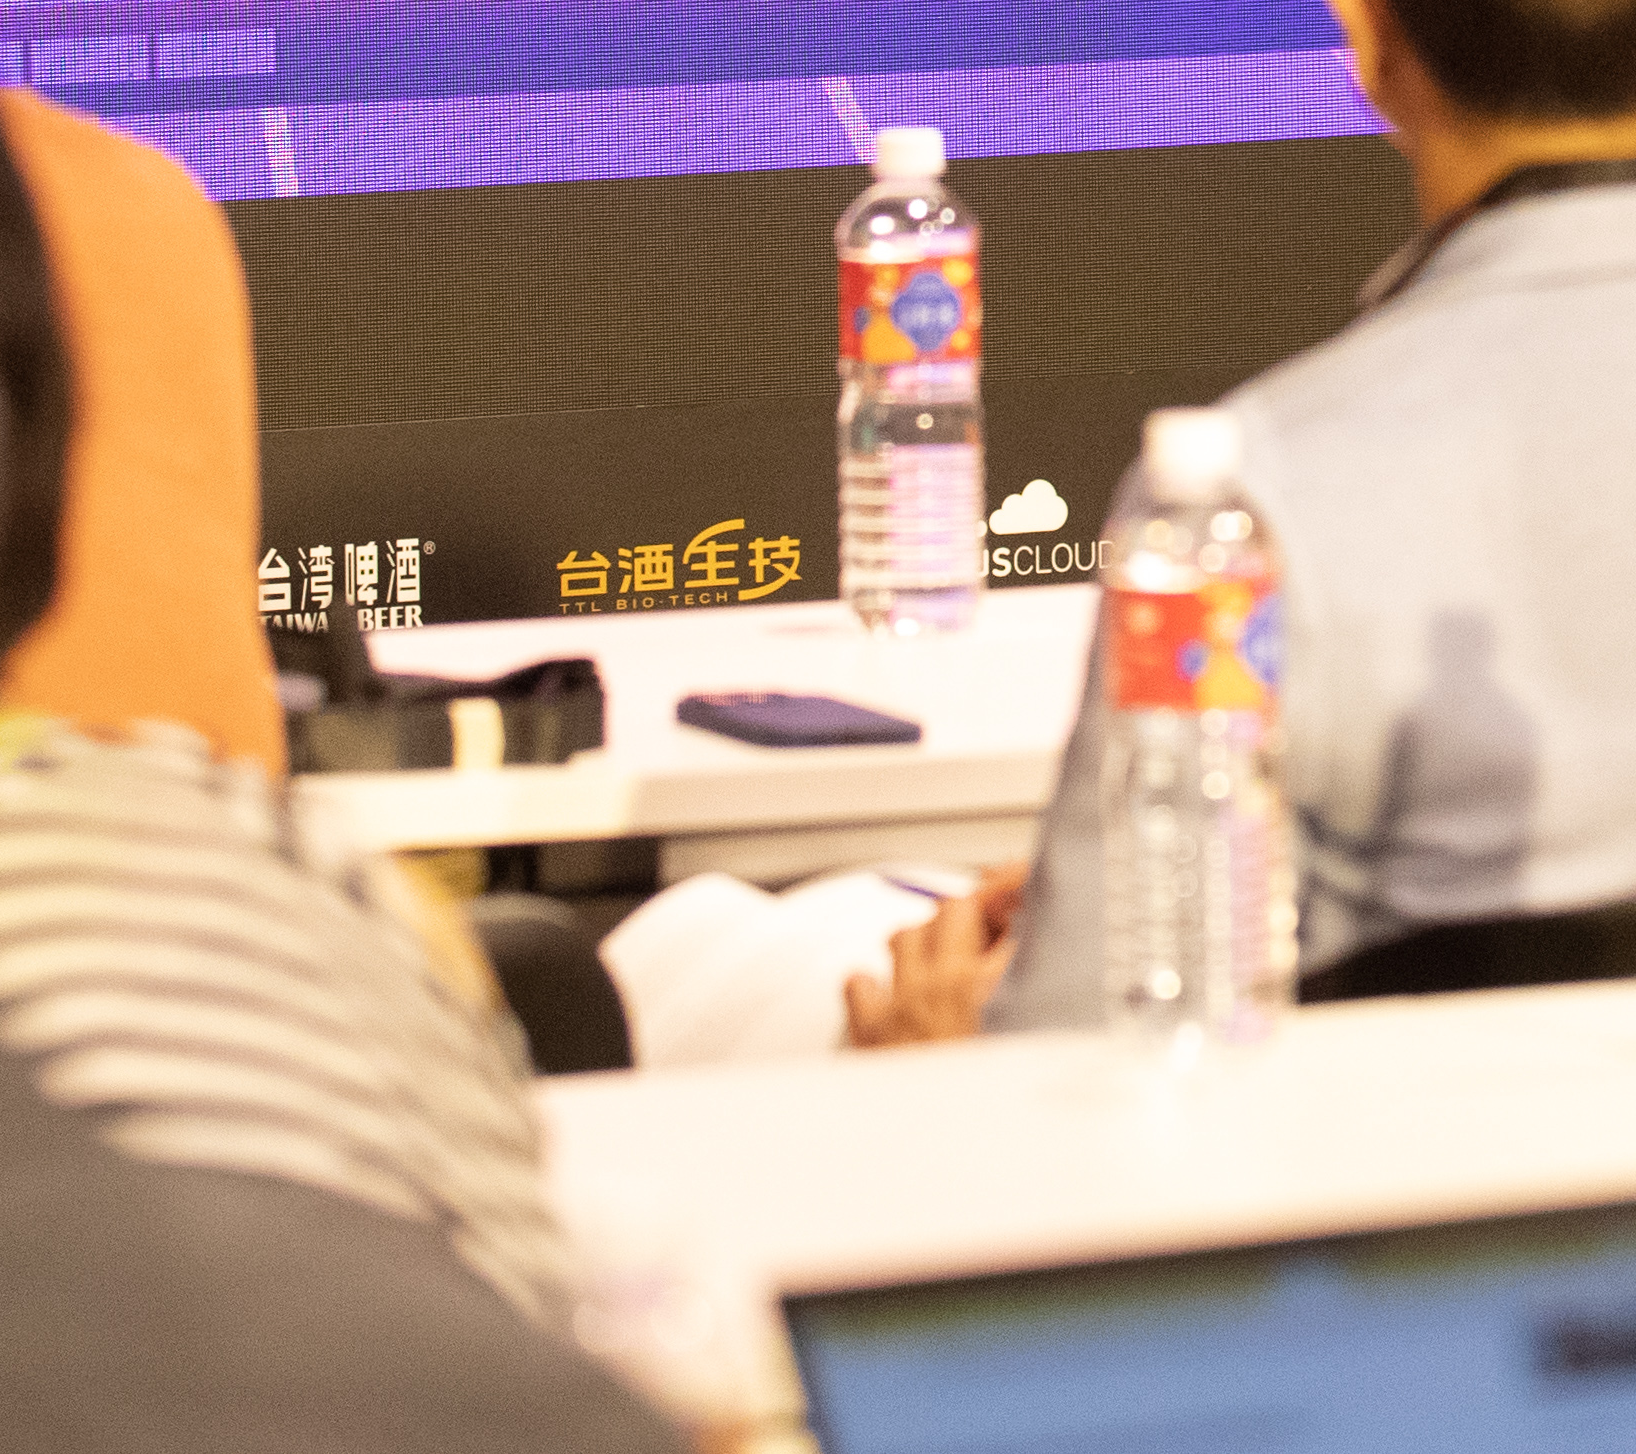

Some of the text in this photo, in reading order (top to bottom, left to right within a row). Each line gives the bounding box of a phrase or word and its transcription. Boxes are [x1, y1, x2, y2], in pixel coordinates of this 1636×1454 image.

[557, 518, 802, 601] 台酒生技
[357, 605, 424, 631] BEER
[559, 601, 602, 615] TTL
